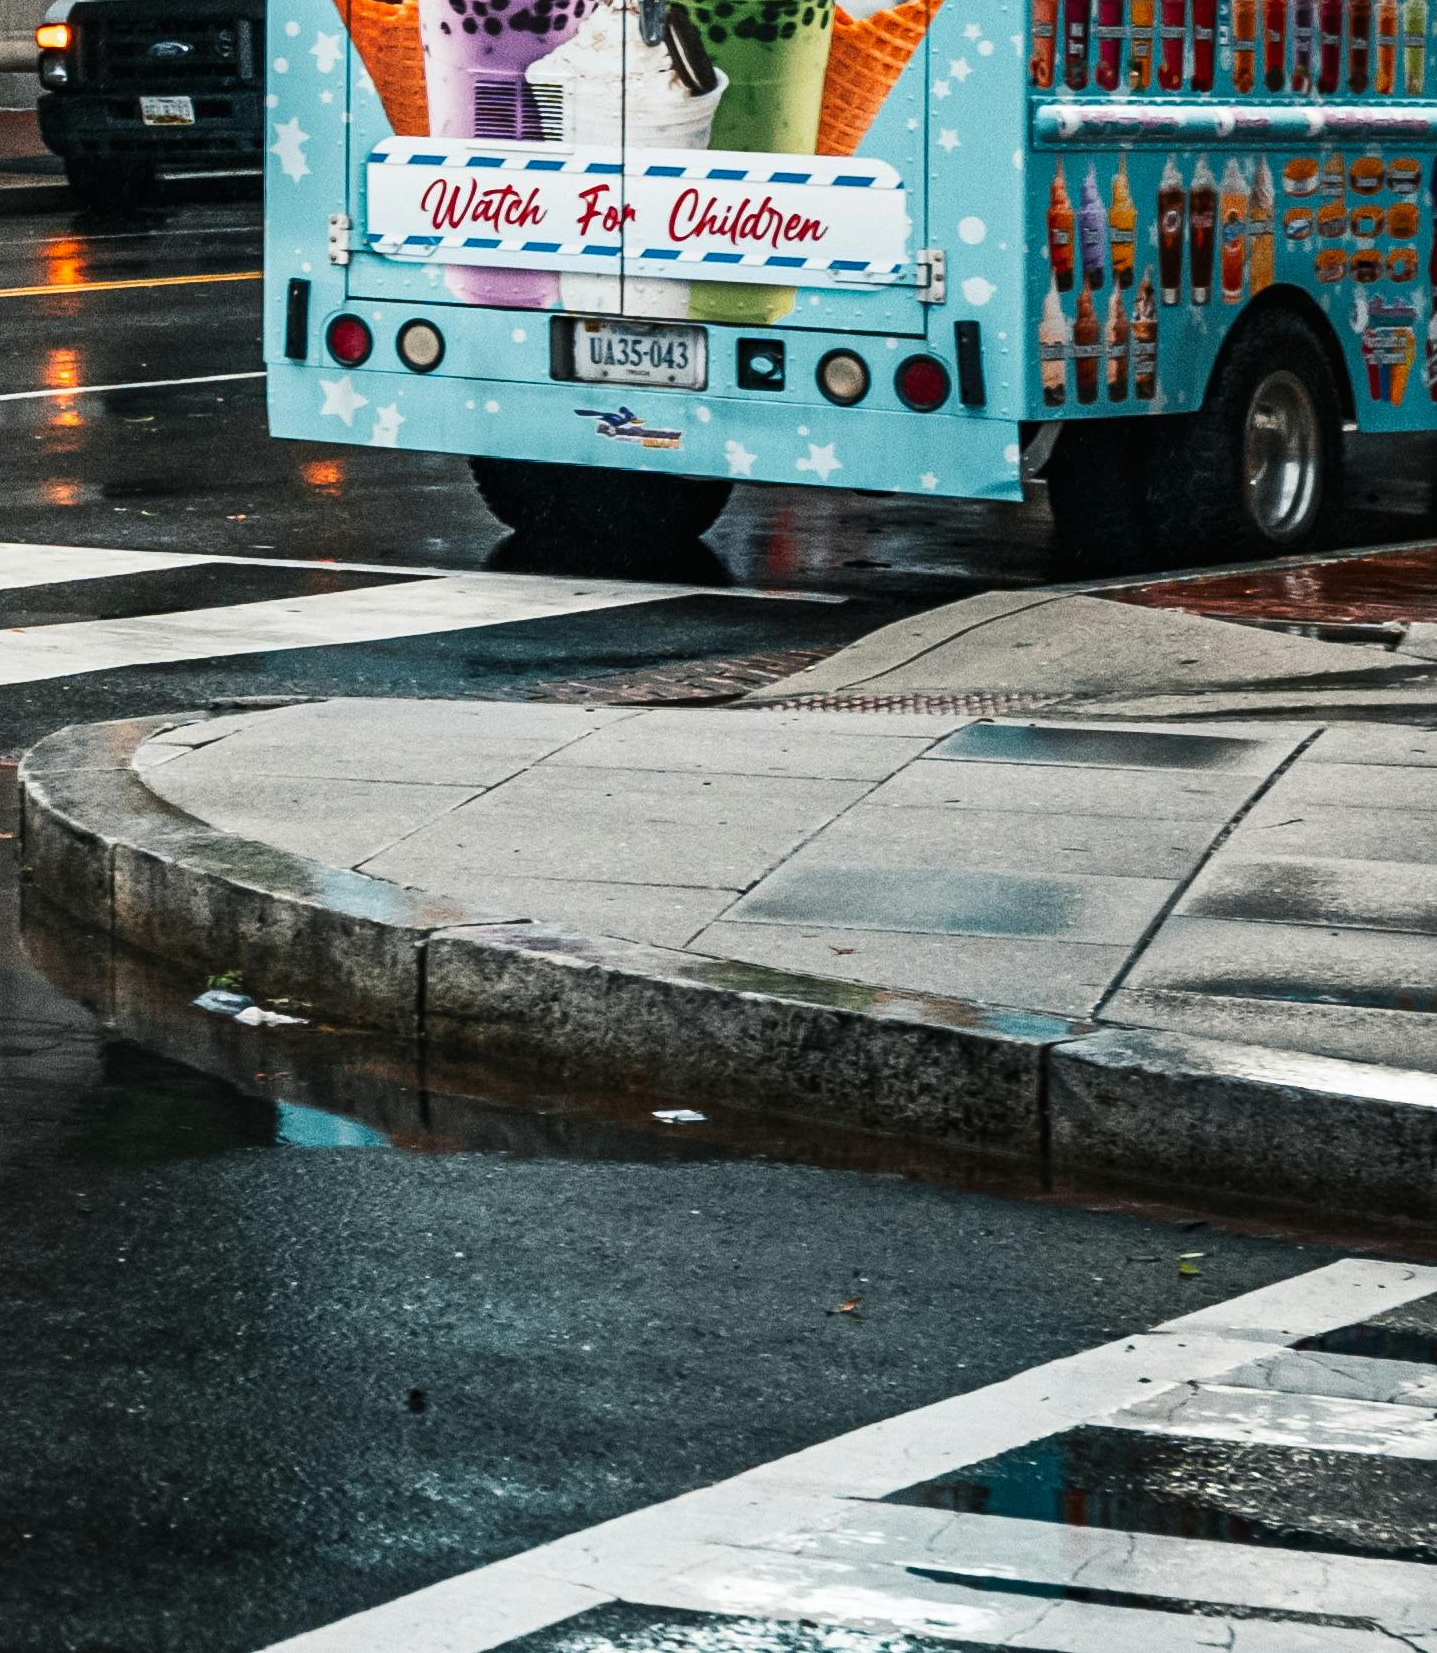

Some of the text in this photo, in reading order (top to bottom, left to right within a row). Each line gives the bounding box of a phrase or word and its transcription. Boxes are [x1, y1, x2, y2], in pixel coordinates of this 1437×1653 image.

[421, 177, 829, 249] Watch For Children
[589, 336, 689, 369] UA35-043
